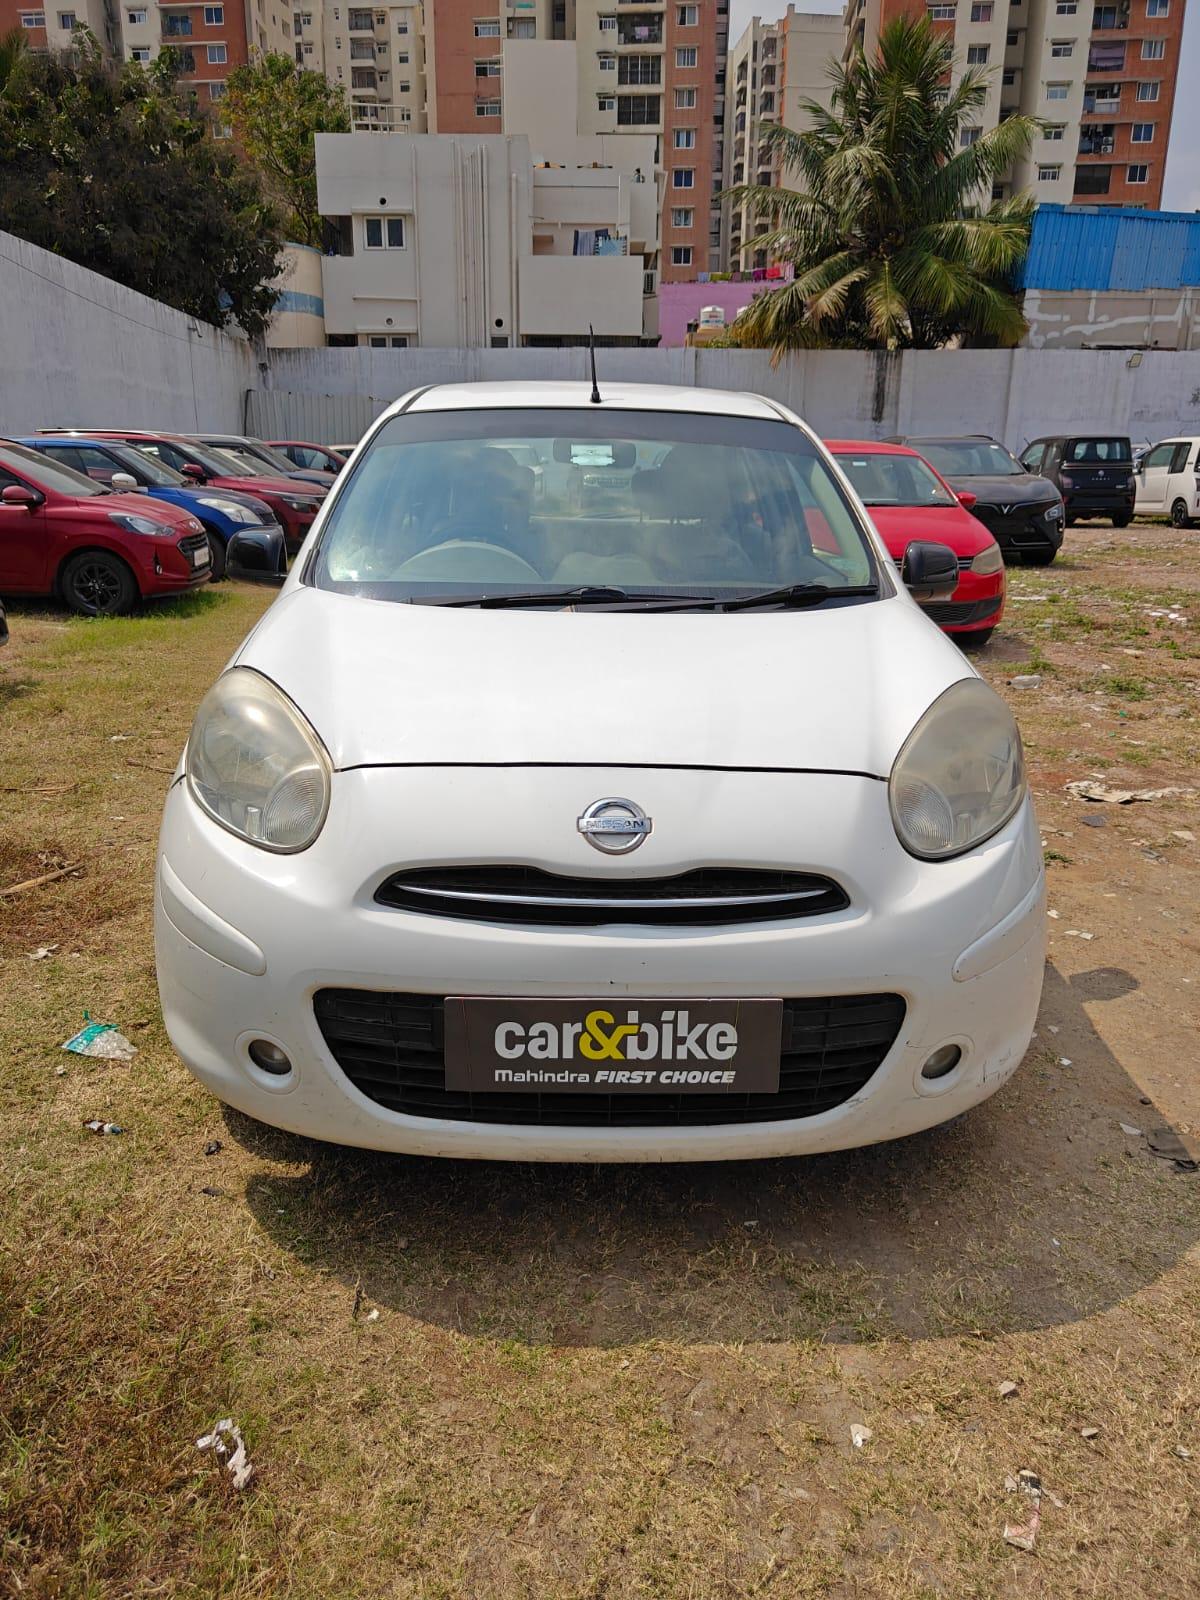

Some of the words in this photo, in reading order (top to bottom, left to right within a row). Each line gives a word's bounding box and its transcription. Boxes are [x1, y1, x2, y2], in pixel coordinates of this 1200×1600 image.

[494, 1010, 738, 1061] car&bike
[494, 1069, 590, 1083] Mahindra
[594, 1070, 657, 1084] FIRST
[660, 1070, 736, 1084] CHOICE
